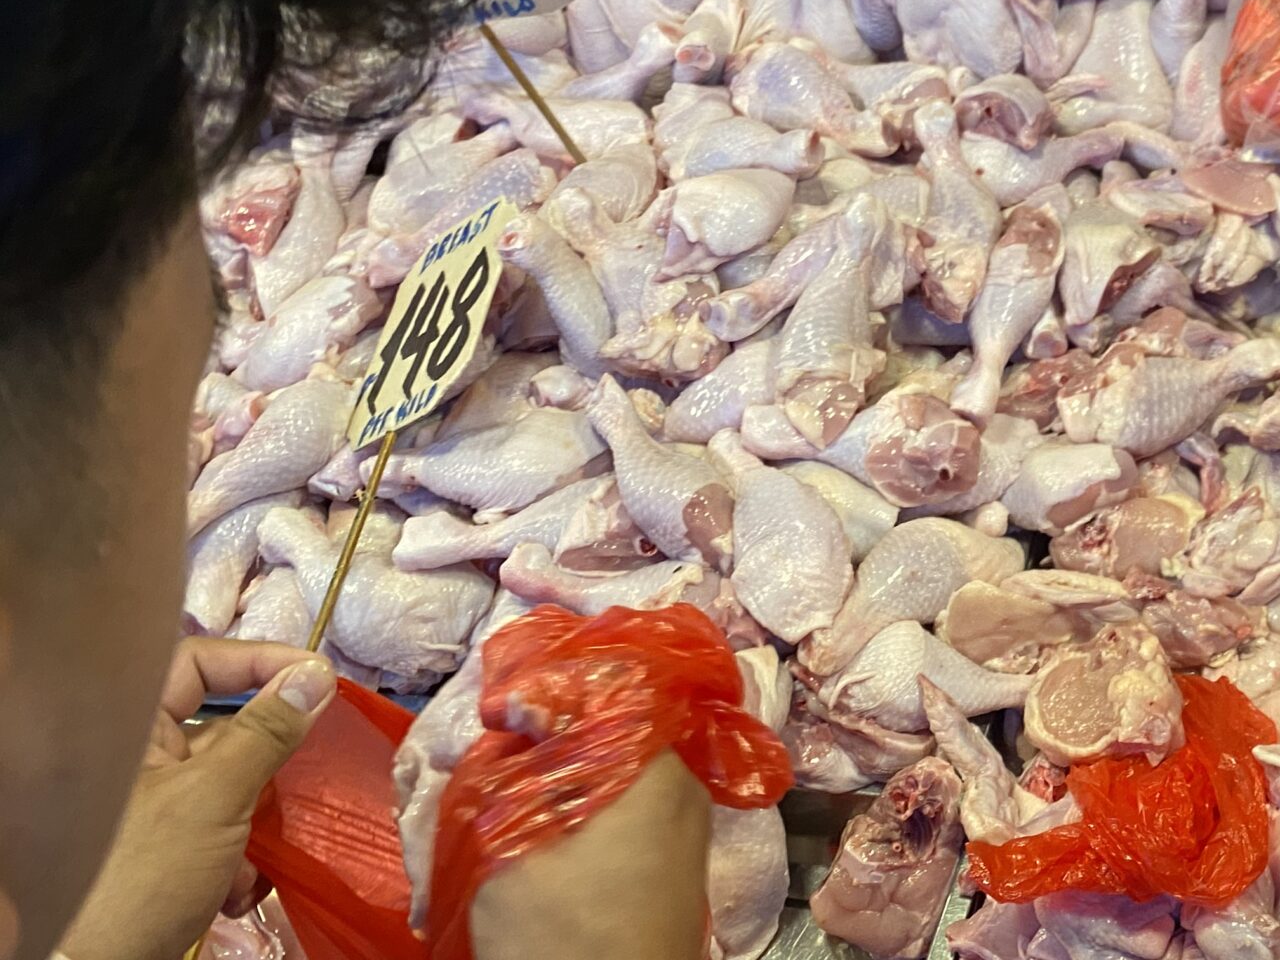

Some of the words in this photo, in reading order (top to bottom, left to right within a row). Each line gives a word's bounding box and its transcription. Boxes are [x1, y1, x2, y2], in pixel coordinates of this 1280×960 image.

[419, 201, 500, 276] BREAST
[367, 246, 489, 416] 148
[396, 383, 437, 425] KILO
